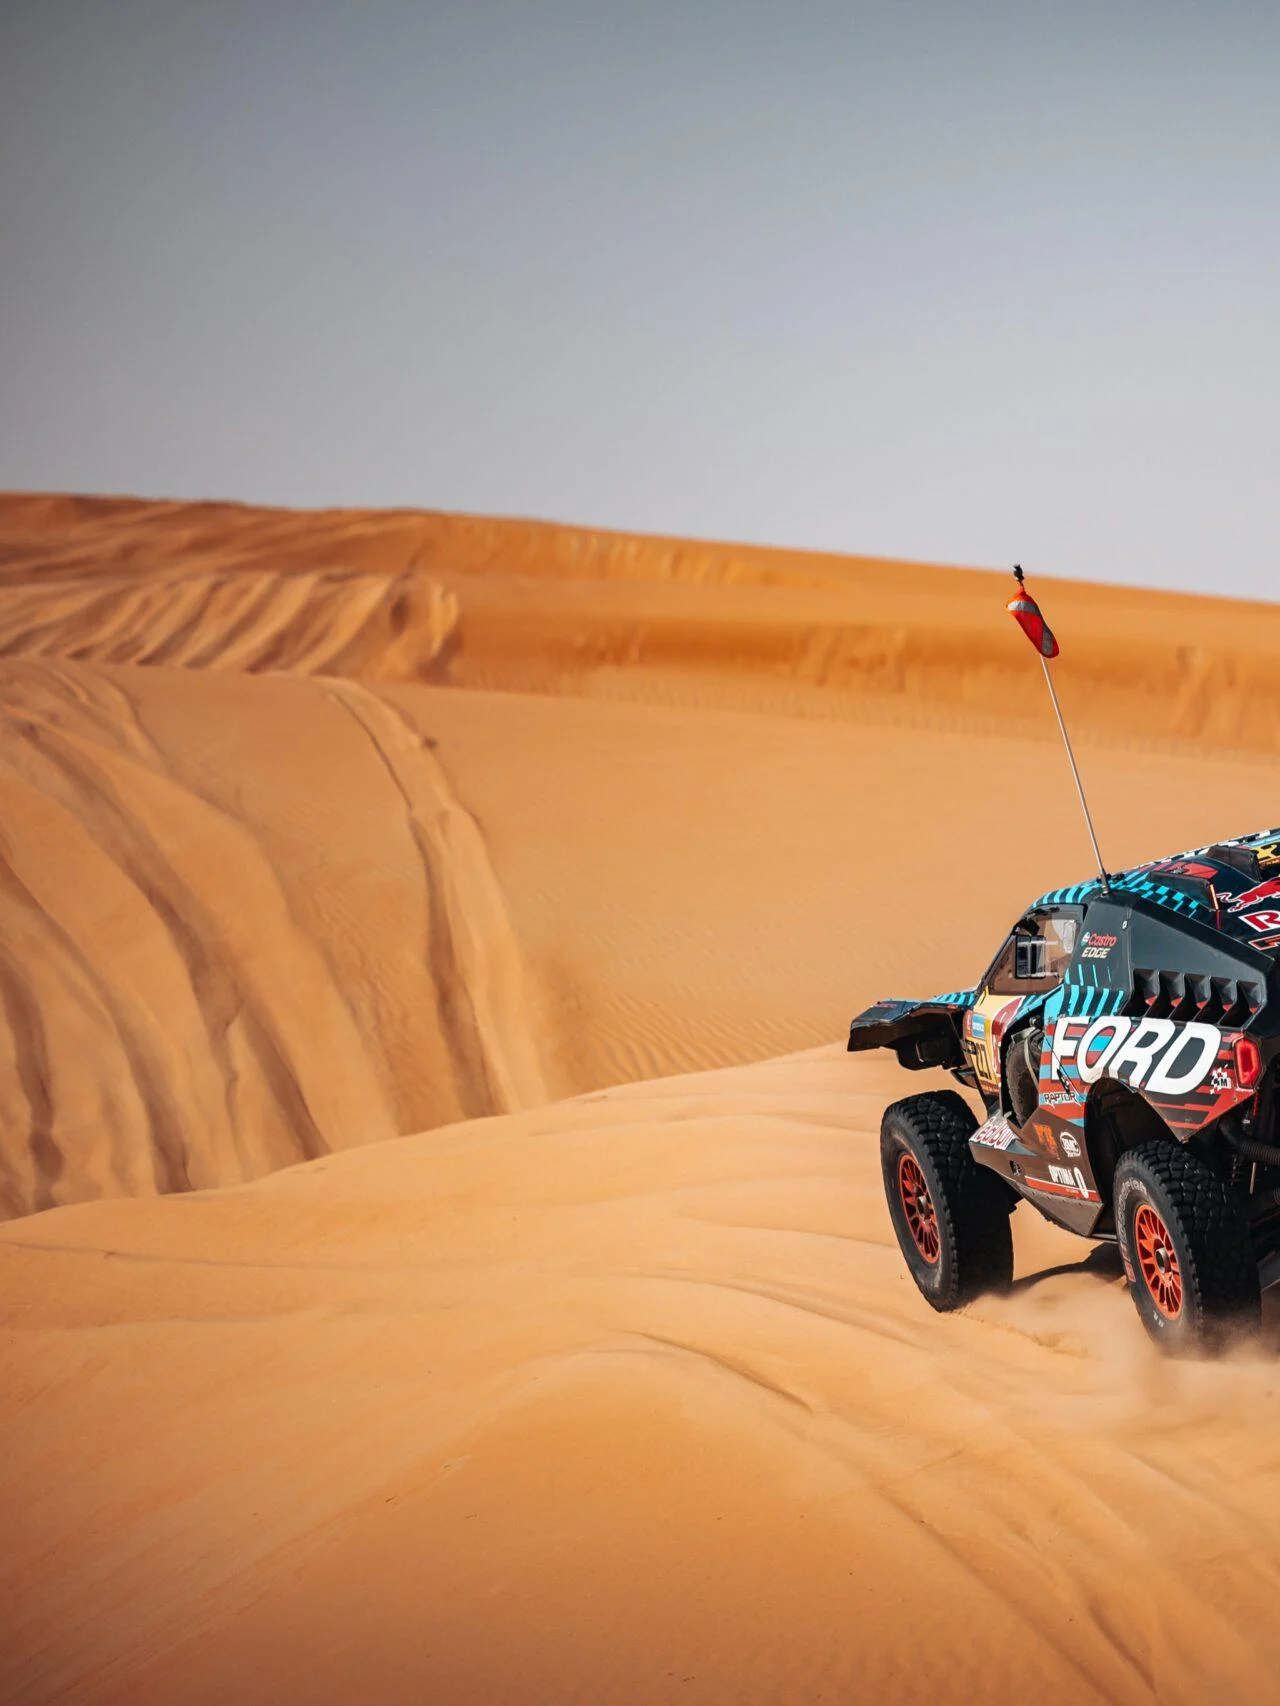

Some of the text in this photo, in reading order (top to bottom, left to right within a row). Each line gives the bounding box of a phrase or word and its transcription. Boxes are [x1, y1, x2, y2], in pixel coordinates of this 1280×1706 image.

[1082, 947, 1111, 958] EDGE
[1051, 1015, 1222, 1095] FORD
[1042, 1091, 1081, 1109] RAPTOR
